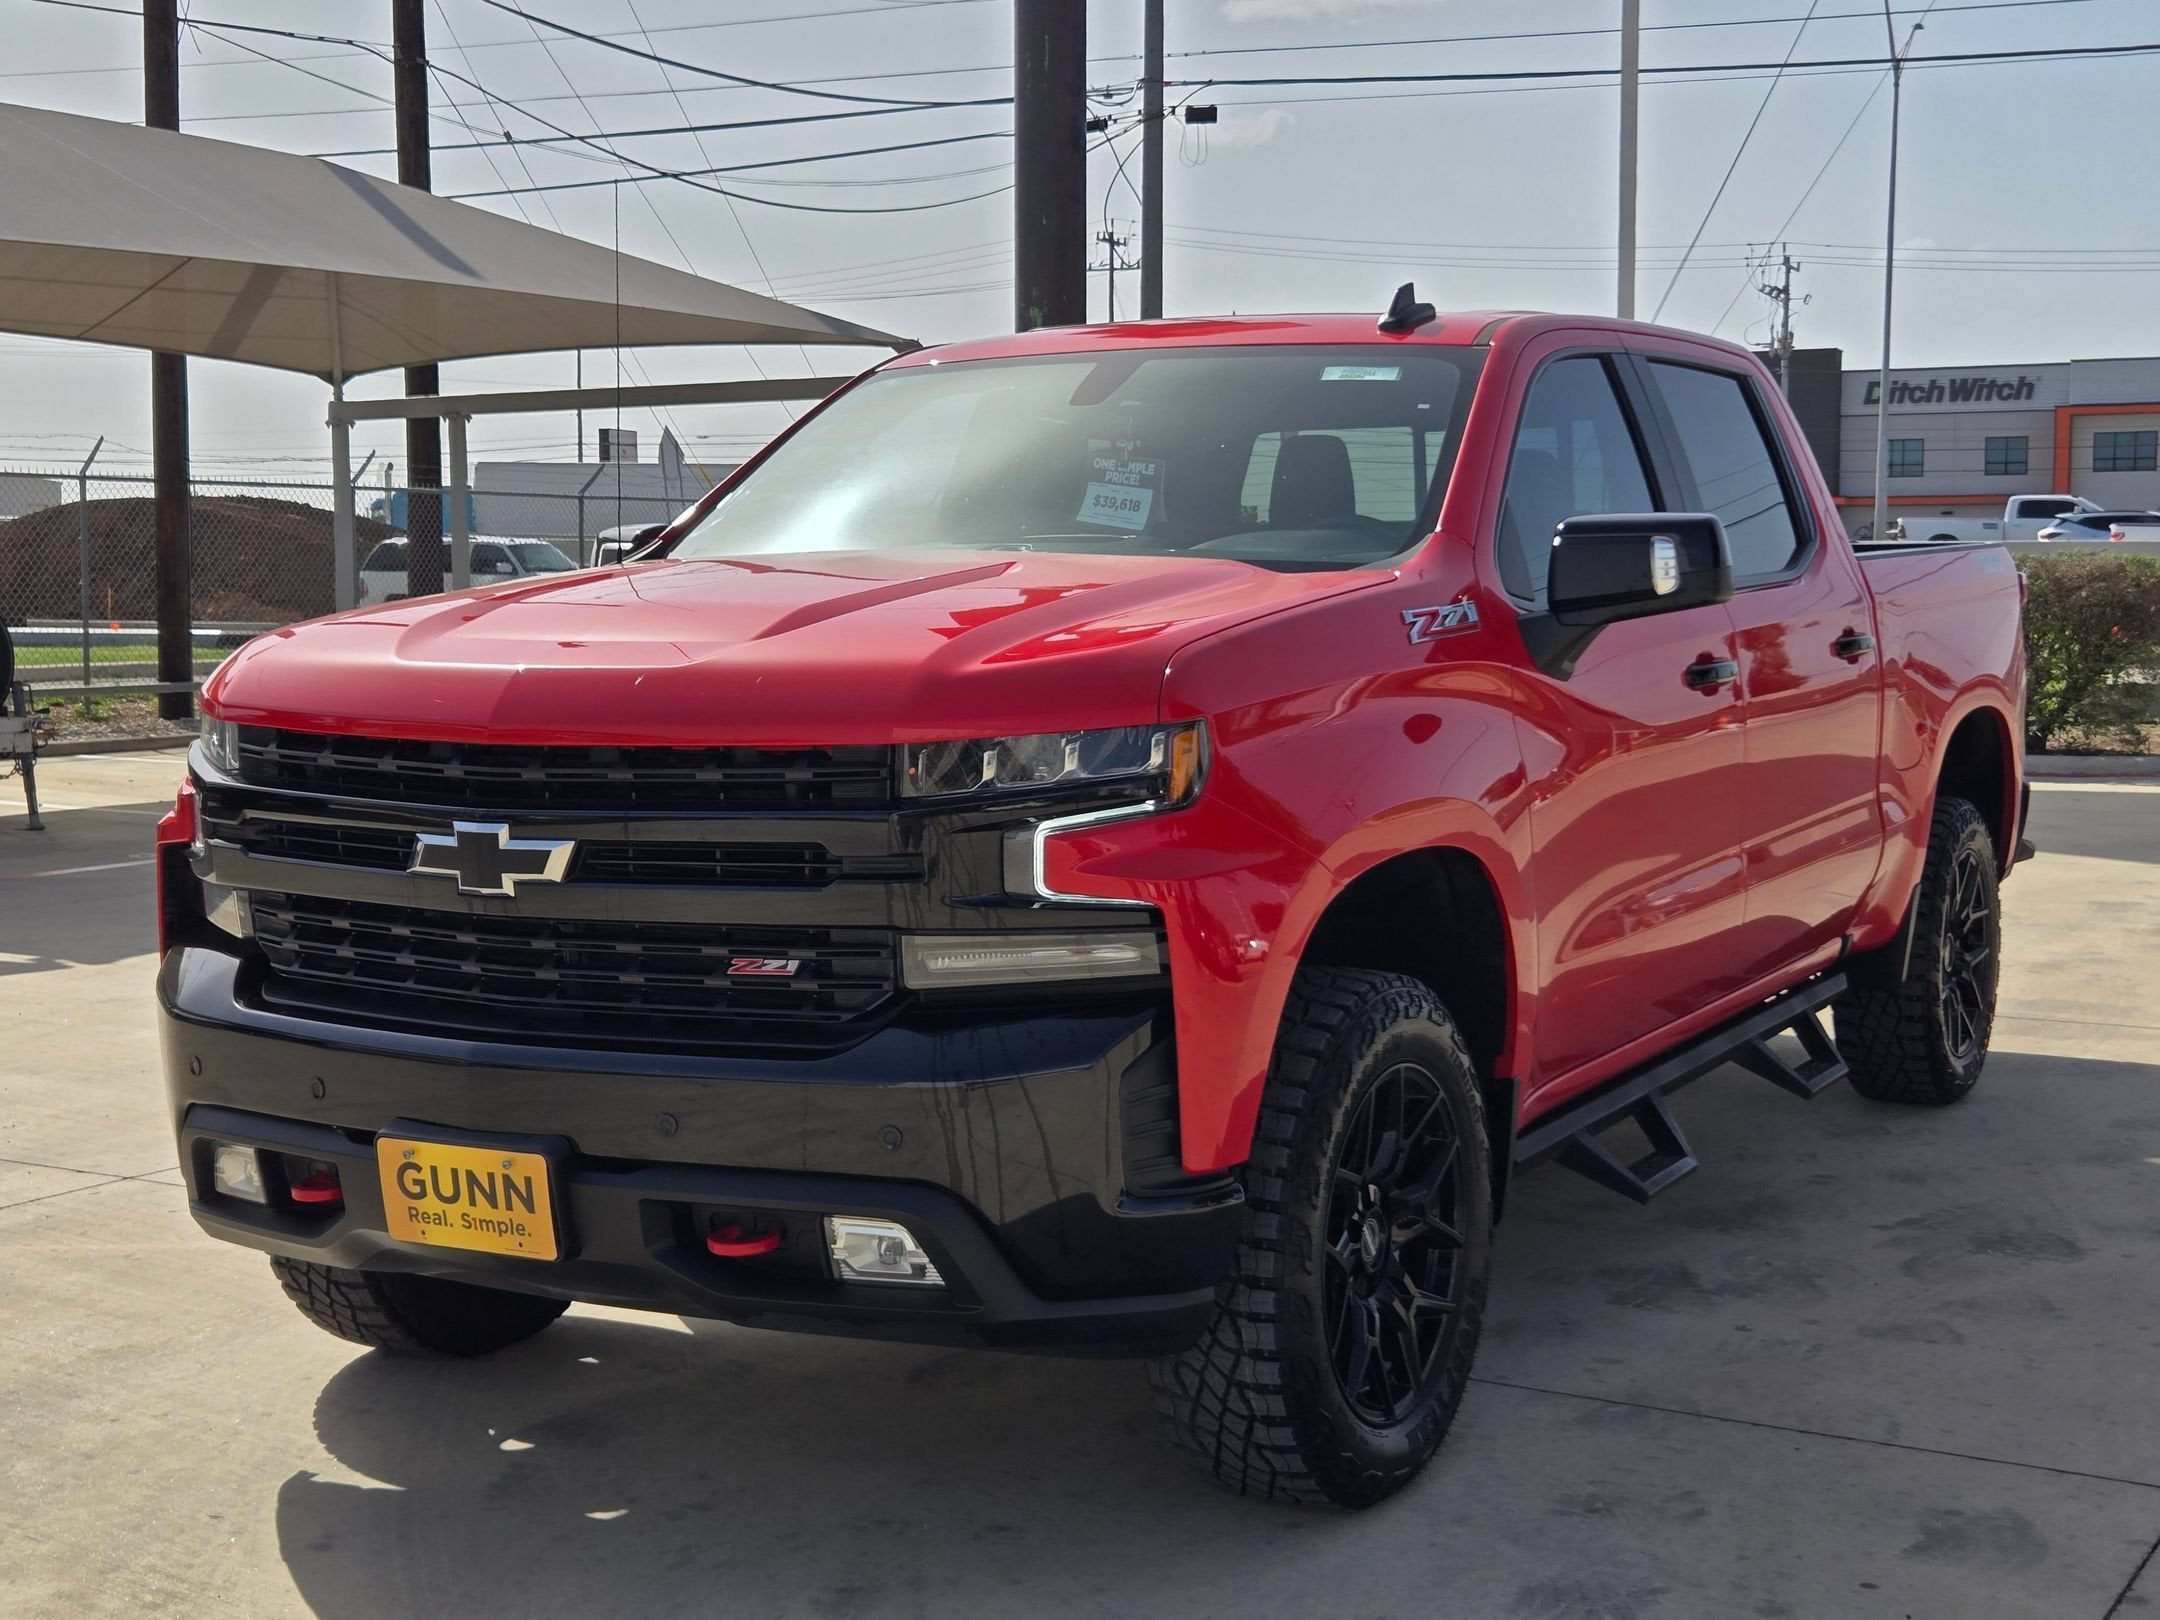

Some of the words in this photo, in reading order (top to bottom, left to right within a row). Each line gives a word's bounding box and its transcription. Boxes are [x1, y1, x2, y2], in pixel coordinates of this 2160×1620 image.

[1863, 380, 1945, 405] Ditch
[1949, 376, 2034, 401] Witch
[1093, 457, 1117, 470] ONE
[1118, 460, 1156, 475] MPLE
[1105, 471, 1140, 486] PRICE!
[1092, 494, 1142, 513] $39,618
[1401, 600, 1480, 645] Z71
[727, 958, 800, 975] Z71
[396, 1161, 536, 1215] GUNN
[408, 1206, 454, 1228] Real.
